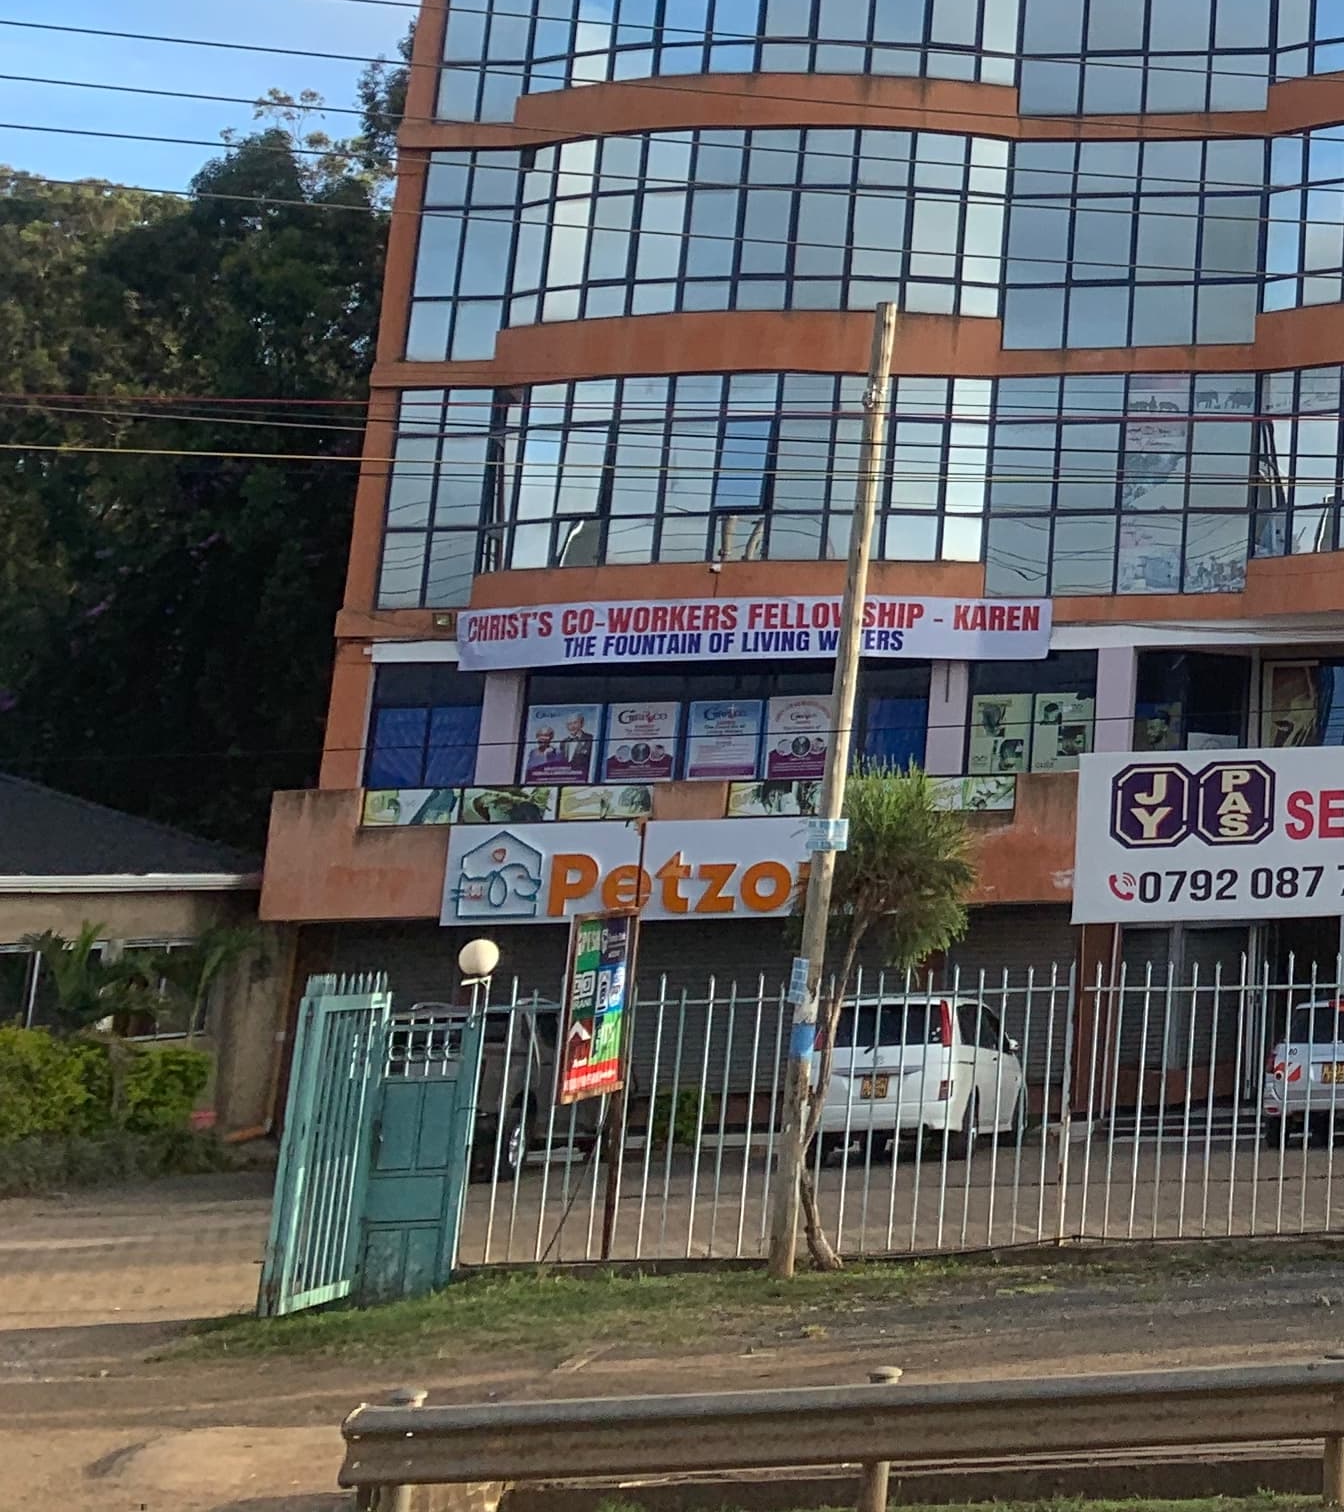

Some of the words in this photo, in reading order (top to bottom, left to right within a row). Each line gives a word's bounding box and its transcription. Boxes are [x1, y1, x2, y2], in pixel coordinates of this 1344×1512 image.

[561, 603, 738, 636] CO-WORKERS
[953, 603, 1040, 631] KAREN
[563, 636, 597, 658] THE
[603, 632, 700, 657] FOUNTAIN
[708, 632, 736, 653] OF
[741, 630, 810, 653] LIVING
[819, 630, 904, 651] WERS
[547, 850, 812, 917] Petzo
[1138, 869, 1239, 903] 0792
[1250, 866, 1325, 899] 087
